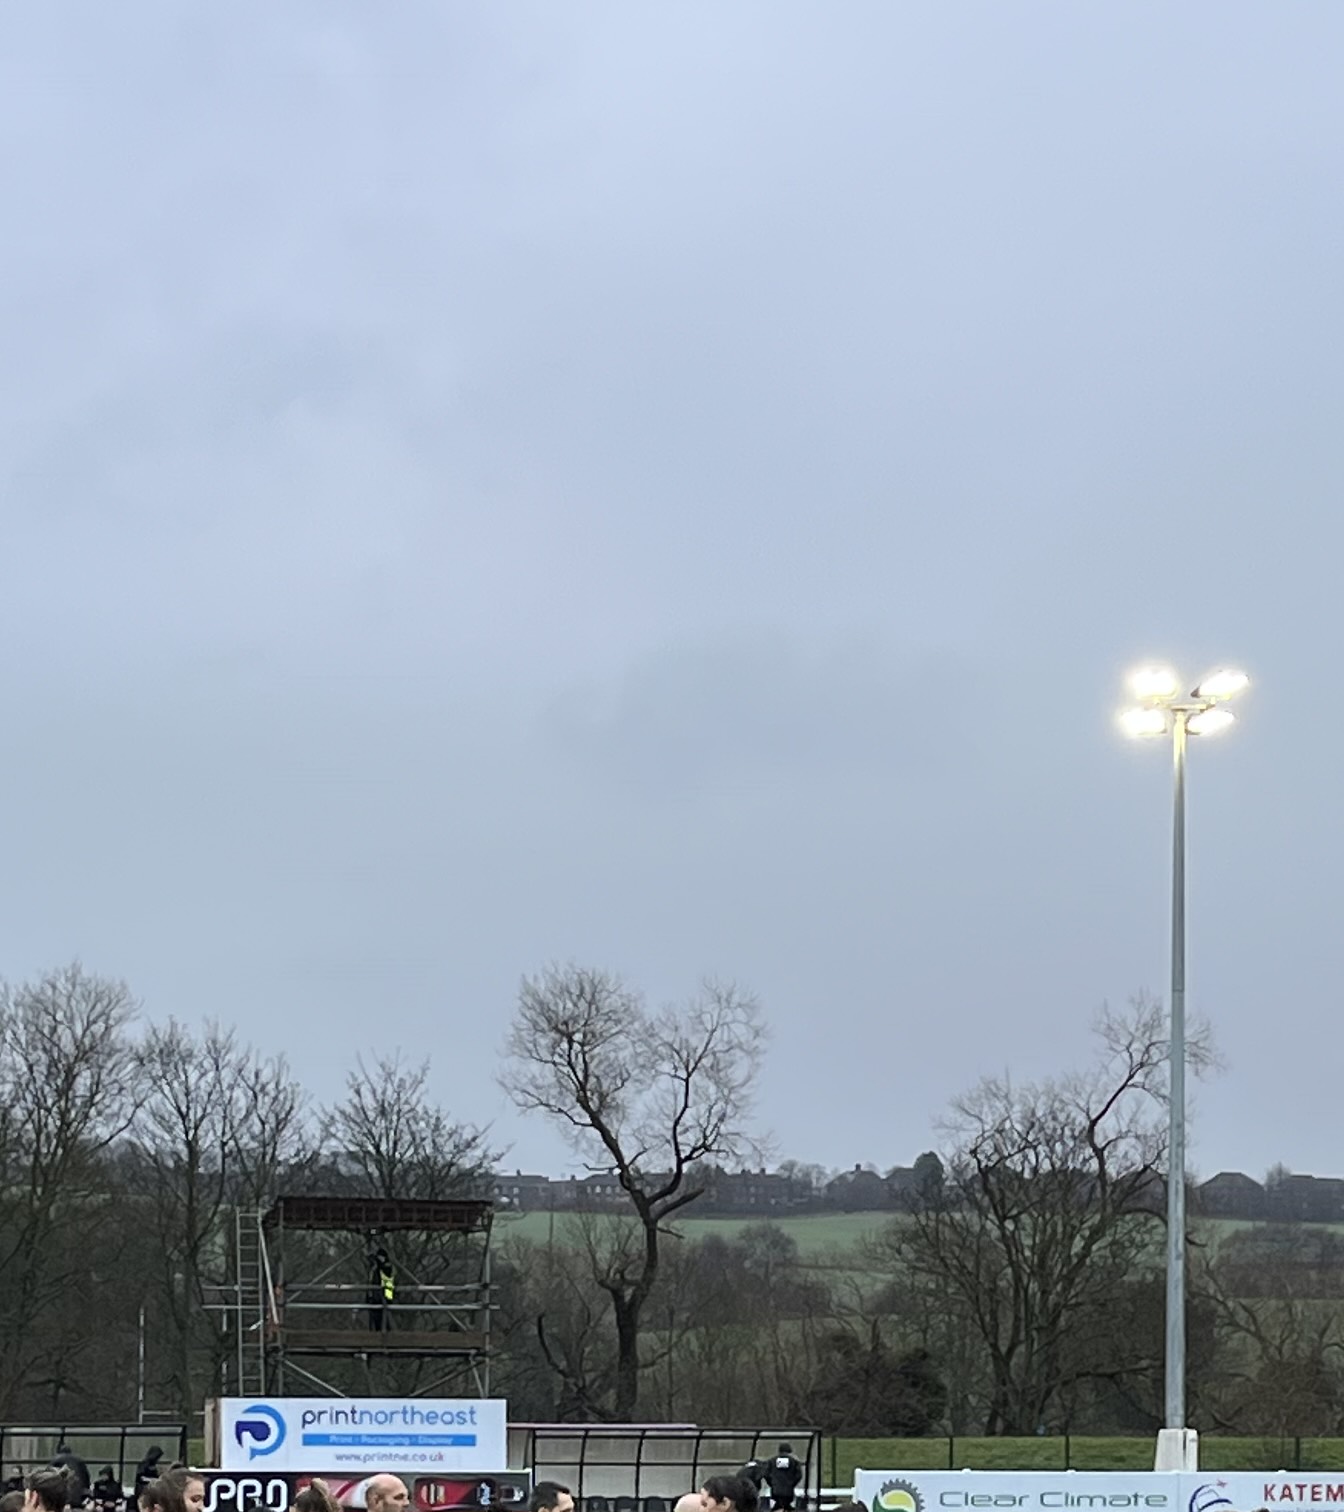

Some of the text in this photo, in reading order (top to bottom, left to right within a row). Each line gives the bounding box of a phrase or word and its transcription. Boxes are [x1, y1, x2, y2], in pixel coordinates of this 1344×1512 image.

[301, 1405, 478, 1429] printnortheast
[939, 1491, 1168, 1507] Clear Climate
[1263, 1484, 1344, 1502] KATEM
